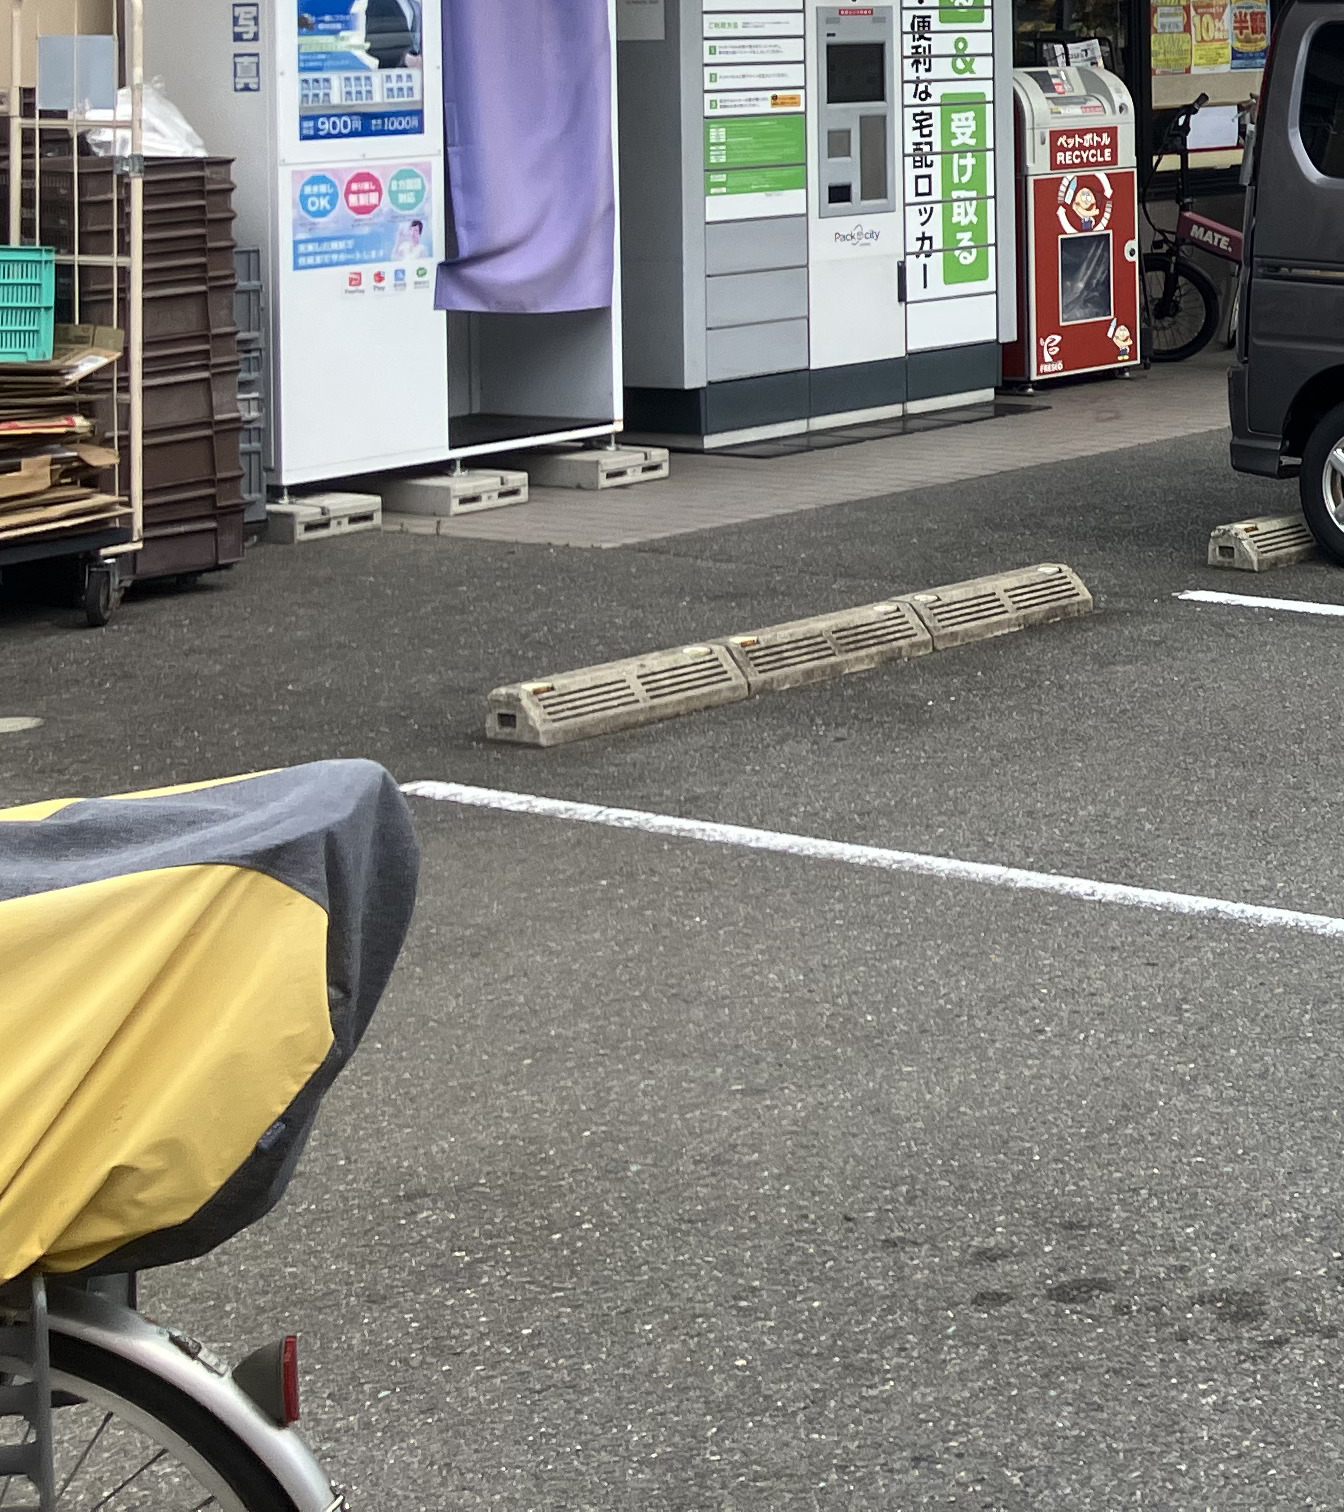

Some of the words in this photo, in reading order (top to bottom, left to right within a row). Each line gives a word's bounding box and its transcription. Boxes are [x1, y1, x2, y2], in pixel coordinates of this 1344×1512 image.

[951, 37, 976, 75] &
[1057, 132, 1110, 148] ペットボトル
[1057, 148, 1112, 165] RECYCLE
[951, 111, 978, 265] 受け取る
[307, 195, 331, 211] OK
[1190, 224, 1232, 252] MATE.
